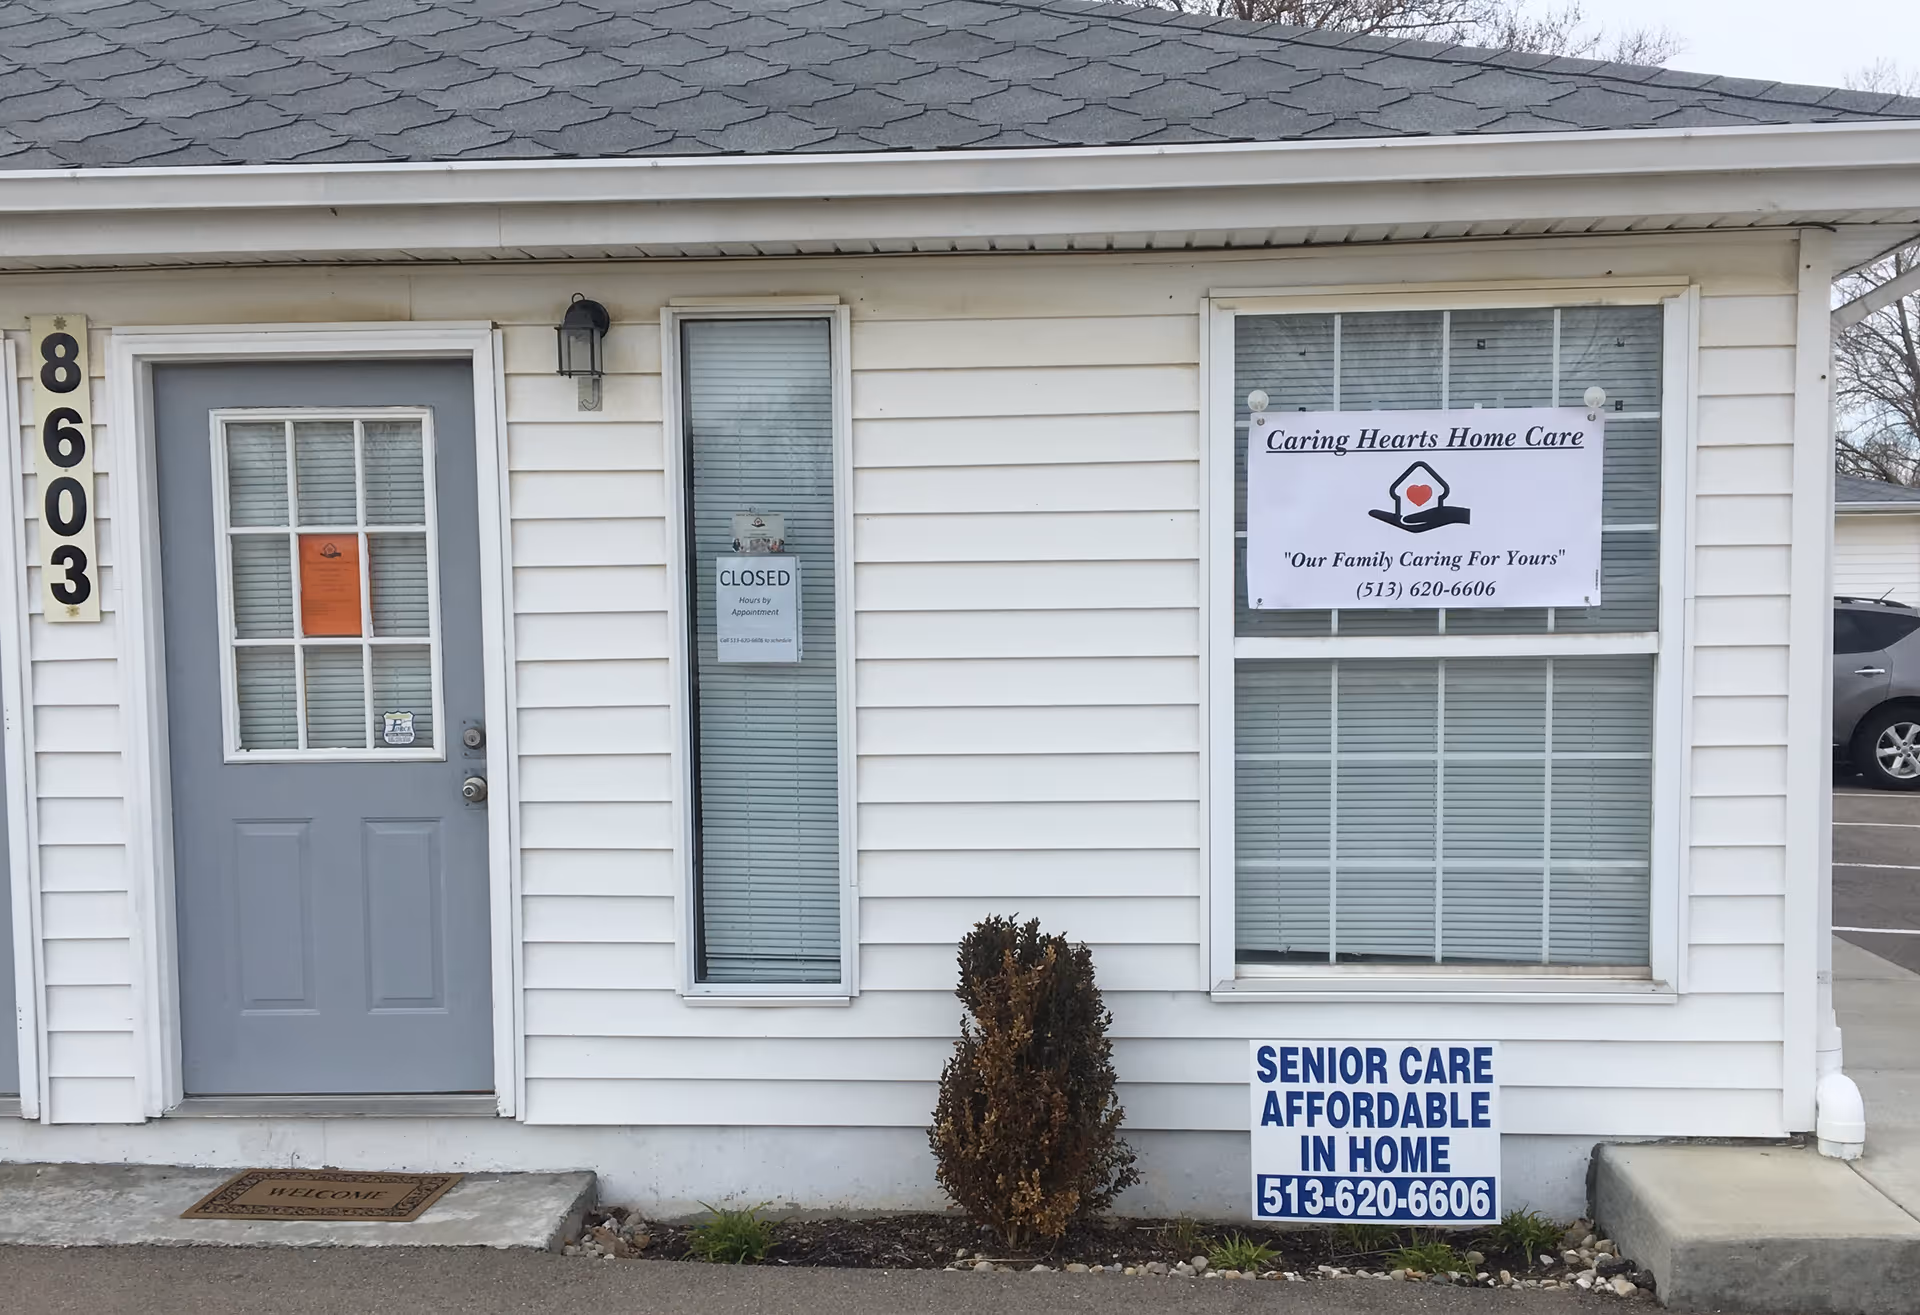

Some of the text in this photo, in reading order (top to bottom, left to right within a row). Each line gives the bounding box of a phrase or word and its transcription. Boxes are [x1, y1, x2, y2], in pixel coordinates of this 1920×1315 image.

[1266, 425, 1584, 457] Caring Hearts Home Care
[40, 332, 91, 605] 8603
[1284, 548, 1566, 572] "Our Family Caring For Yours"
[719, 569, 791, 587] CLOSED
[1355, 579, 1497, 601] (513) 620-6606
[731, 608, 780, 617] Appointment
[738, 596, 772, 606] Hours by
[1256, 1044, 1494, 1085] SENIOR CARE
[1260, 1089, 1492, 1130] AFFORDABLE
[1300, 1134, 1451, 1174] IN HOME
[267, 1187, 388, 1201] WELCOME
[1263, 1177, 1491, 1218] 513-620-6606
